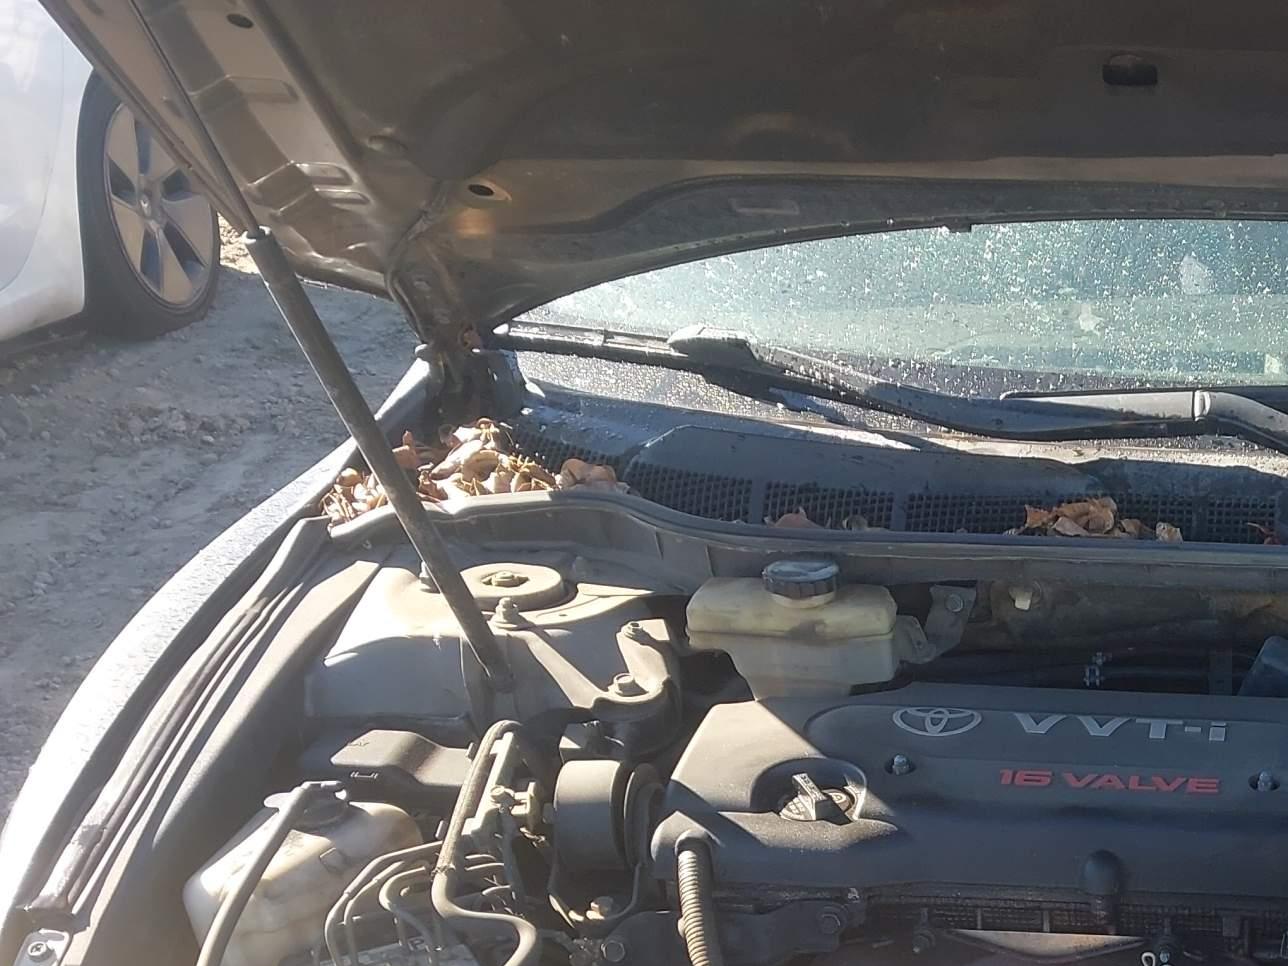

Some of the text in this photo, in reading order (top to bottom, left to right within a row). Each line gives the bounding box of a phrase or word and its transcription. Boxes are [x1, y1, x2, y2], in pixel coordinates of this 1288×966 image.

[1013, 711, 1228, 742] VVT-i
[999, 768, 1221, 794] 16 VALVE
